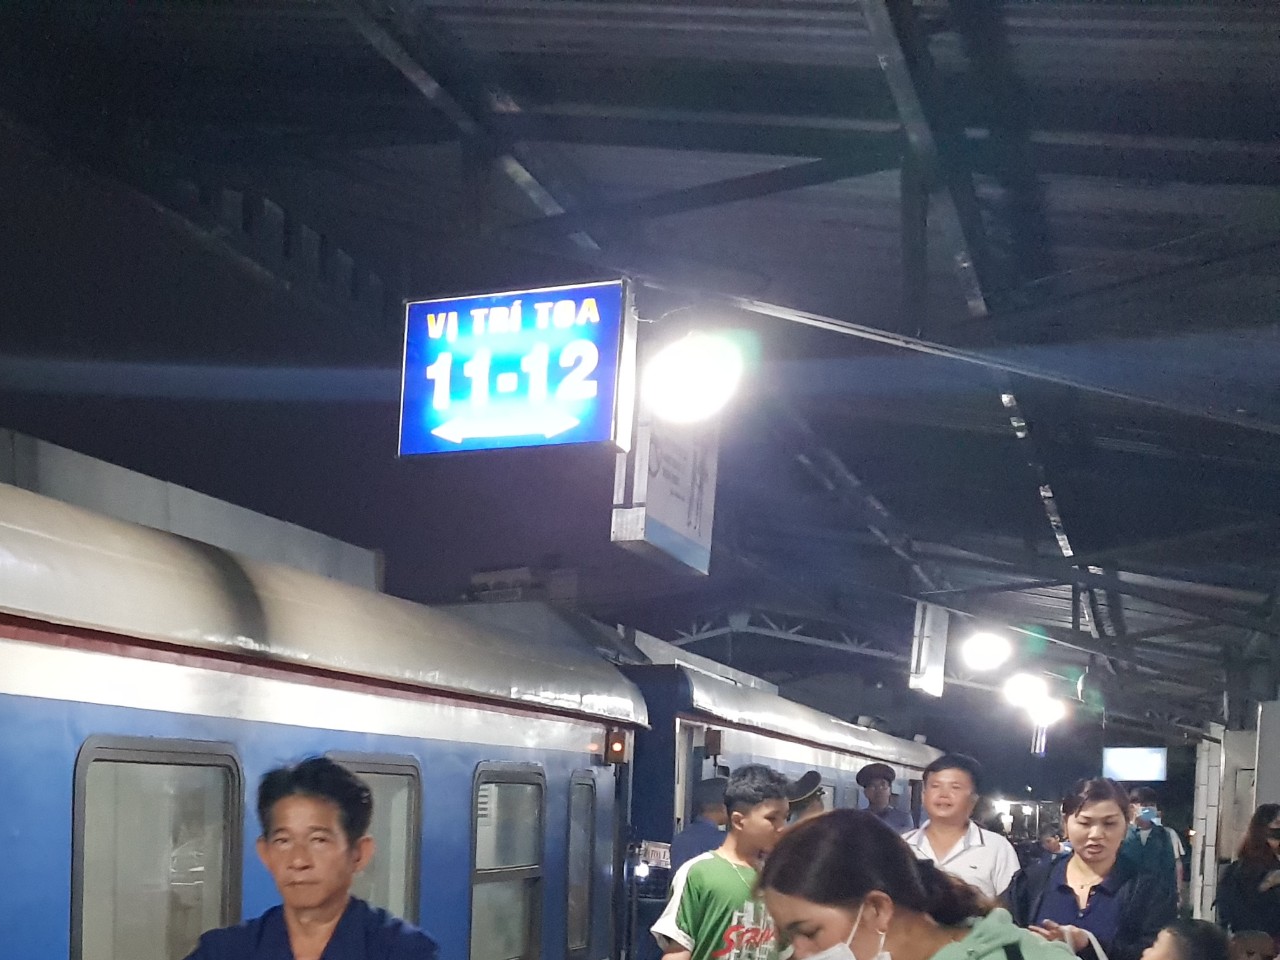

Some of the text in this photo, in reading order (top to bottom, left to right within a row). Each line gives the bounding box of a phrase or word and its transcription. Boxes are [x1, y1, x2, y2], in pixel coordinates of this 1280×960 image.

[470, 300, 522, 335] TRÍ
[534, 298, 600, 330] TOA
[426, 338, 599, 410] 11-12
